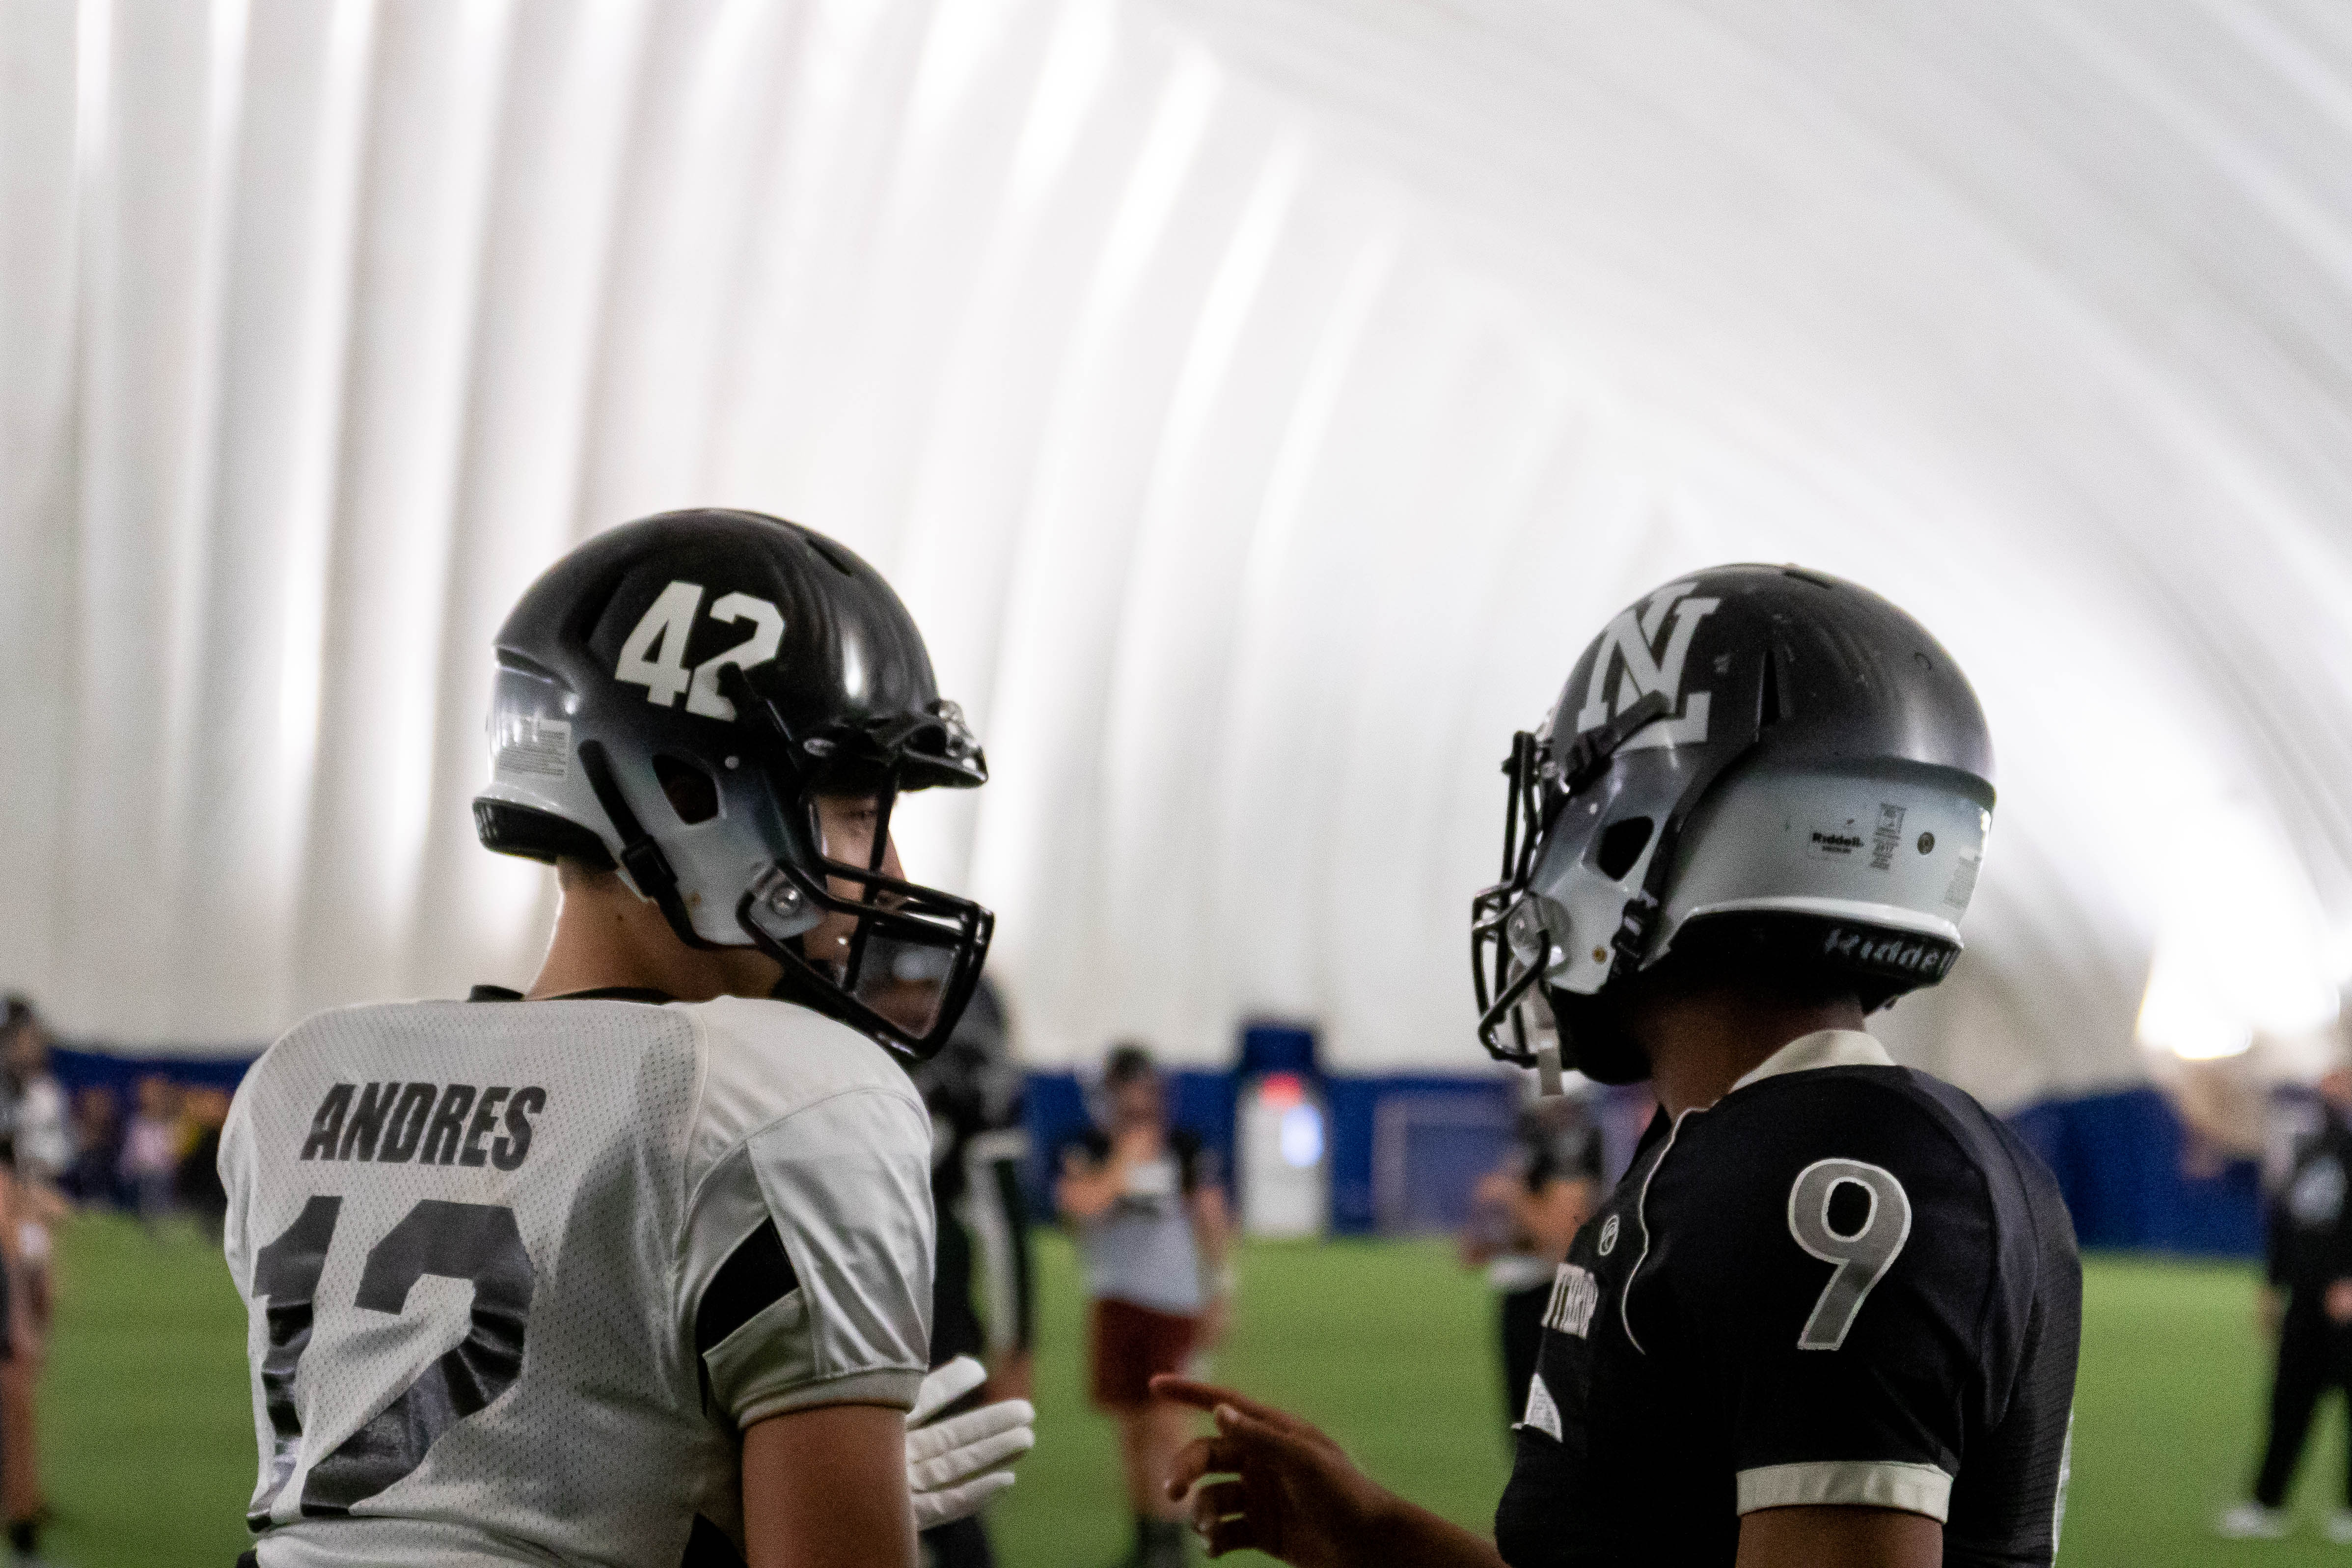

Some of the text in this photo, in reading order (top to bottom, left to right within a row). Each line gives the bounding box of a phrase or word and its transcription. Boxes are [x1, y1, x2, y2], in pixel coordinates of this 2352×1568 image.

[615, 580, 785, 722] 42
[300, 1082, 547, 1171] ANDRES
[1788, 1157, 1912, 1351] 9
[246, 1196, 535, 1533] 12
